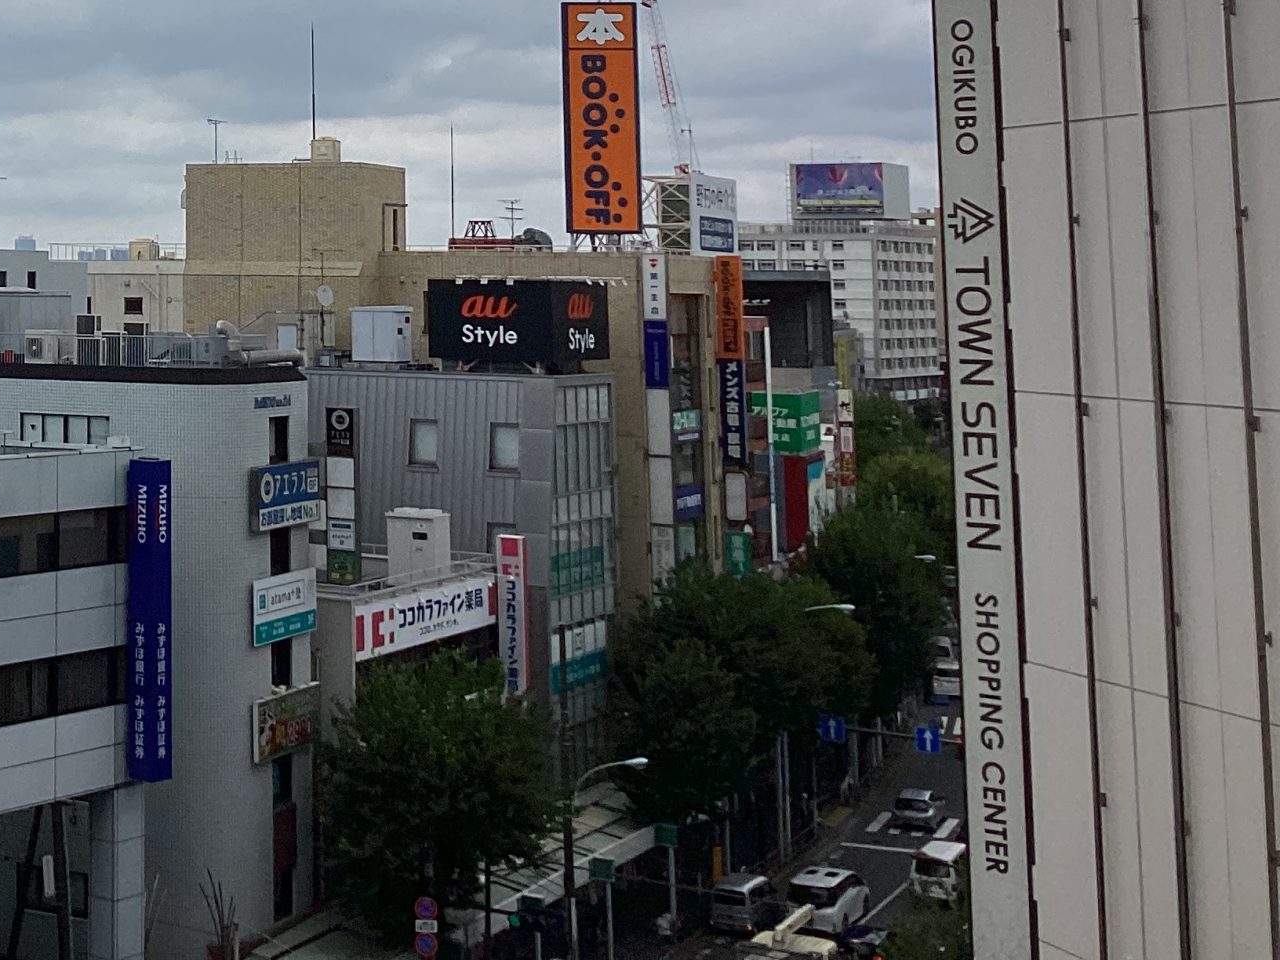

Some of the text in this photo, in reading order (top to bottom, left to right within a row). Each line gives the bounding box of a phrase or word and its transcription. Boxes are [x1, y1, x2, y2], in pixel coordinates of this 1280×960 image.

[576, 8, 625, 45] 本
[950, 18, 979, 156] OGIKUBO
[461, 293, 518, 318] au
[567, 293, 594, 320] au
[461, 324, 518, 347] Style
[568, 327, 596, 354] Style
[954, 255, 1003, 552] TOWN SEVEN
[274, 470, 307, 498] アエラス
[137, 484, 148, 544] MIZUHO
[158, 484, 168, 544] MIZUHO
[398, 588, 484, 629] ココカラファイン薬局
[135, 622, 145, 760] みずほ銀行 みずほ証券
[157, 622, 166, 760] みずほ銀行 みずほ証券
[975, 591, 1010, 876] SHOPPING CENTER
